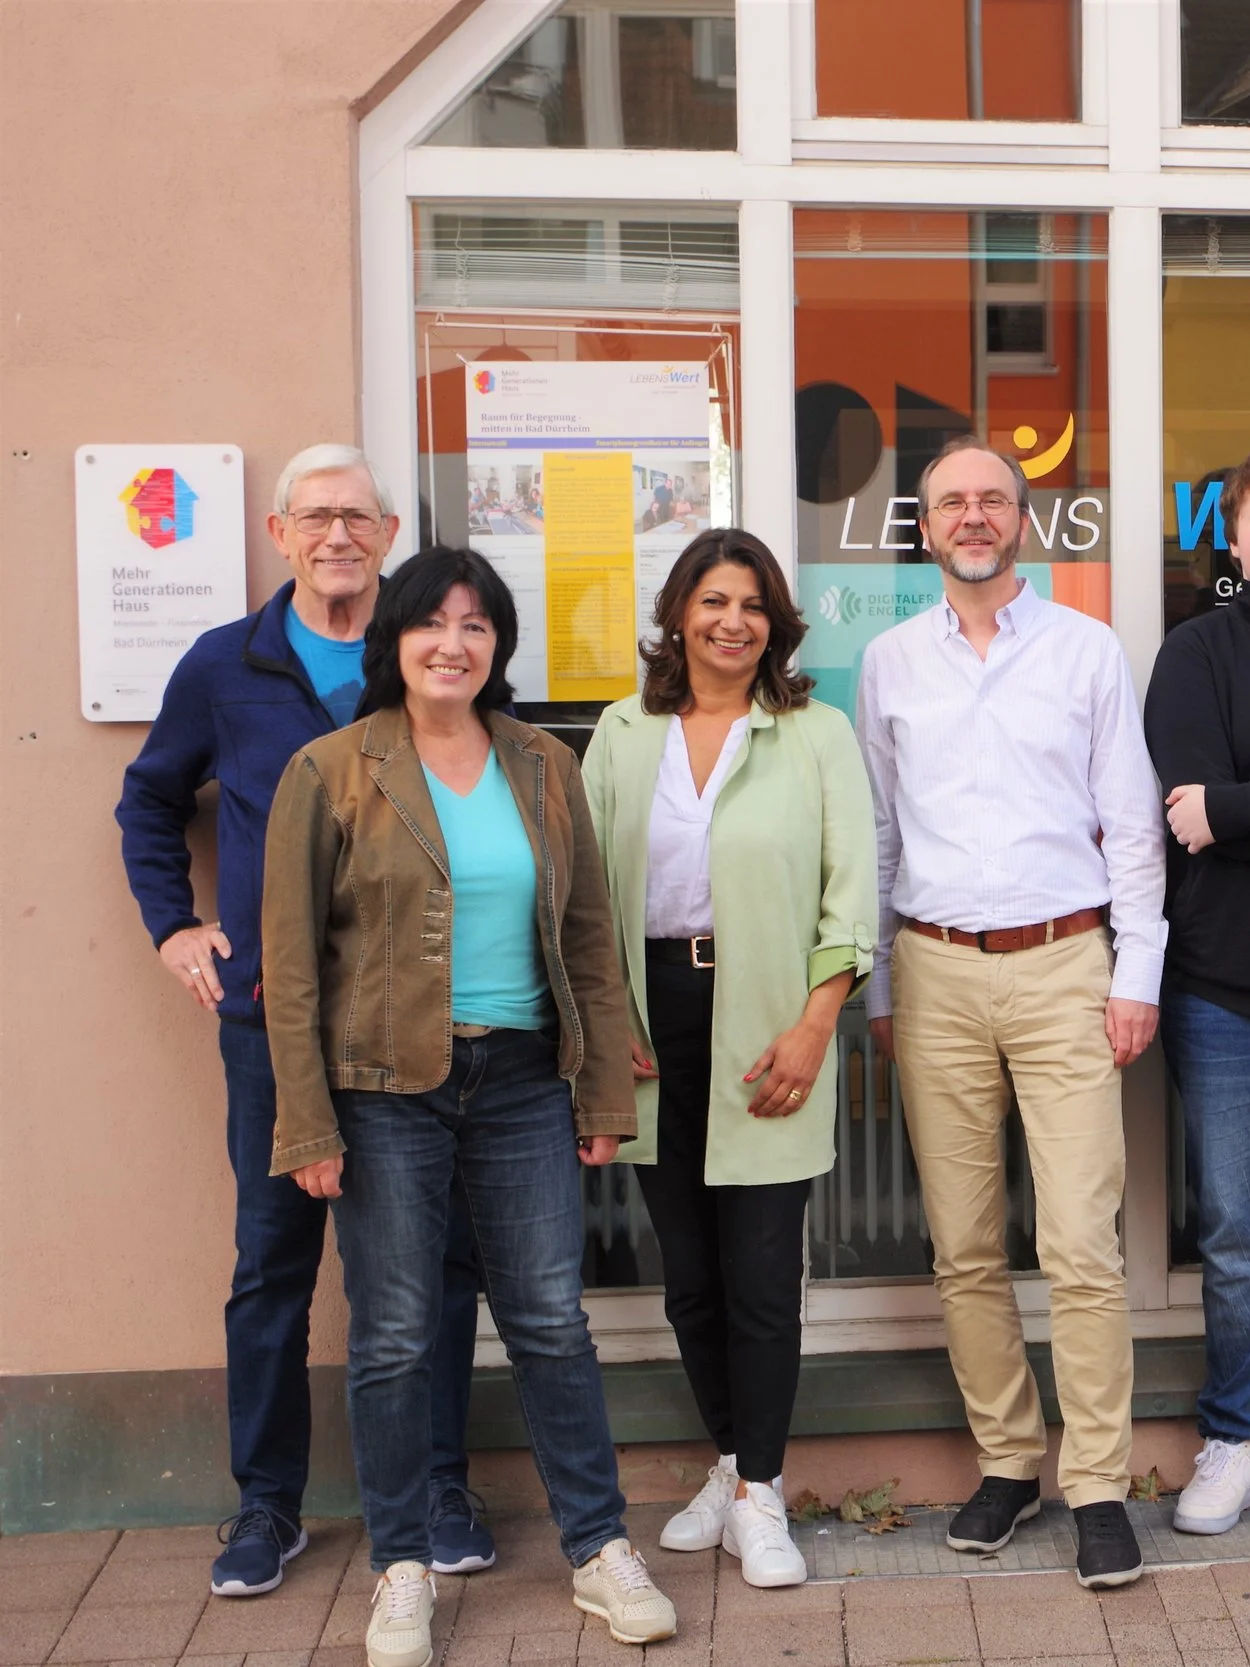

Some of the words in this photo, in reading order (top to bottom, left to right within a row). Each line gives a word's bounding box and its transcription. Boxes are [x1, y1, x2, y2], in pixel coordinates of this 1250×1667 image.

[481, 413, 508, 421] Raum
[526, 413, 577, 423] Begegnung
[481, 425, 512, 433] mitten
[514, 425, 523, 433] in
[525, 425, 543, 433] Bad
[839, 497, 1104, 551] LENS
[112, 567, 151, 580] Mehr
[112, 583, 213, 596] Generationen
[868, 594, 934, 605] DIGITALER
[113, 600, 150, 612] Haus
[868, 606, 910, 616] ENGEL
[114, 637, 134, 648] Bad
